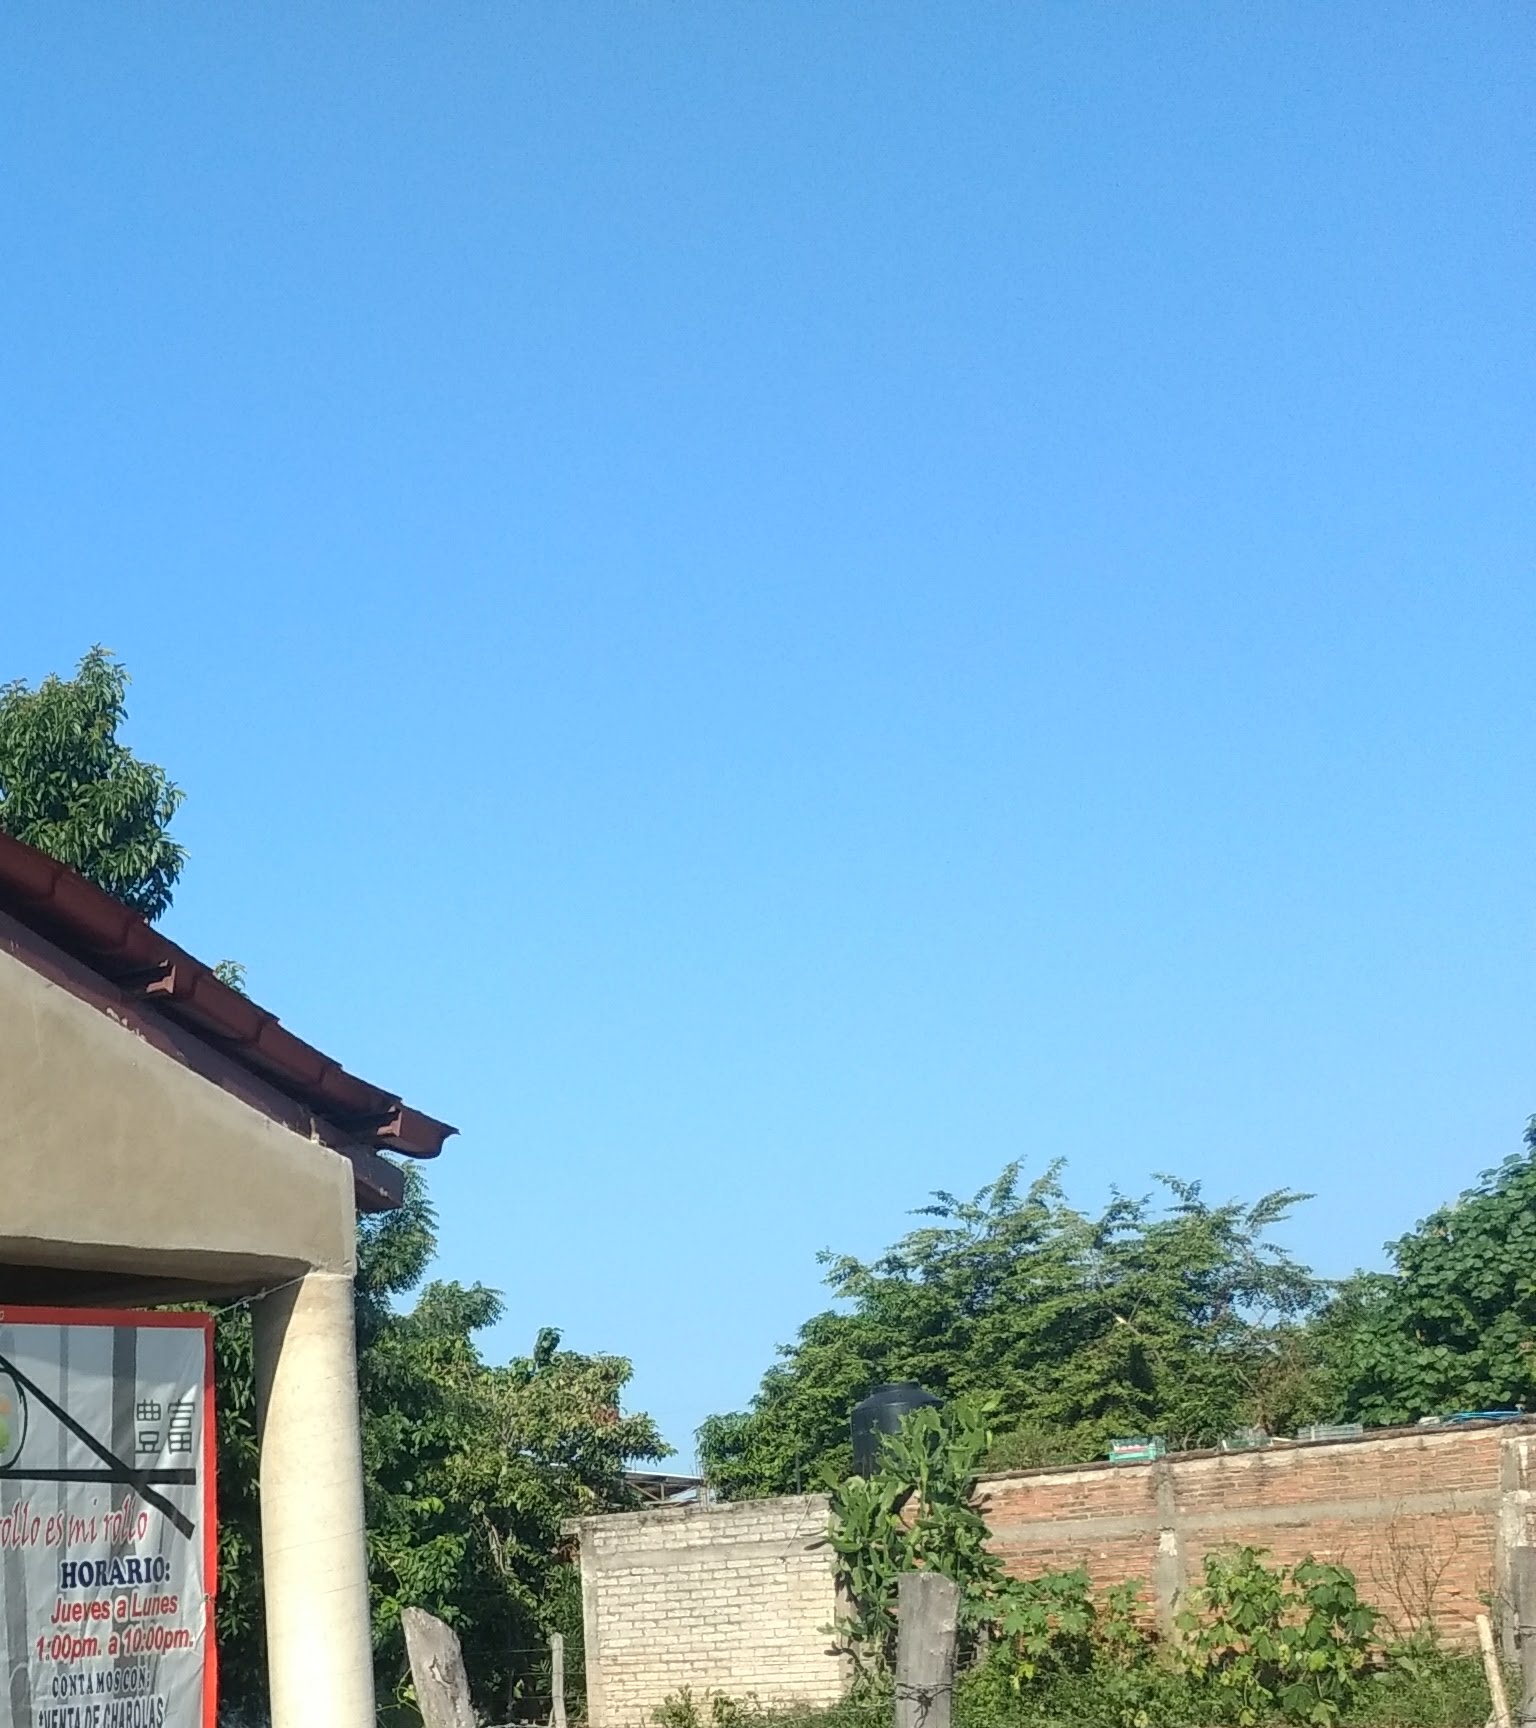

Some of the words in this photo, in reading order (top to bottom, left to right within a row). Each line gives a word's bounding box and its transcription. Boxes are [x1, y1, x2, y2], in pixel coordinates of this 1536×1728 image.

[46, 1512, 64, 1547] es
[68, 1498, 97, 1548] mi
[103, 1496, 148, 1546] rollo
[60, 1556, 171, 1590] HORARIO:
[50, 1596, 111, 1625] Jueves
[116, 1600, 127, 1618] a
[131, 1592, 179, 1617] Lunes
[36, 1633, 103, 1664] 1:00pm.
[108, 1636, 118, 1656] a
[123, 1626, 194, 1655] 10:00pm.
[52, 1671, 120, 1698] CONTAMOS
